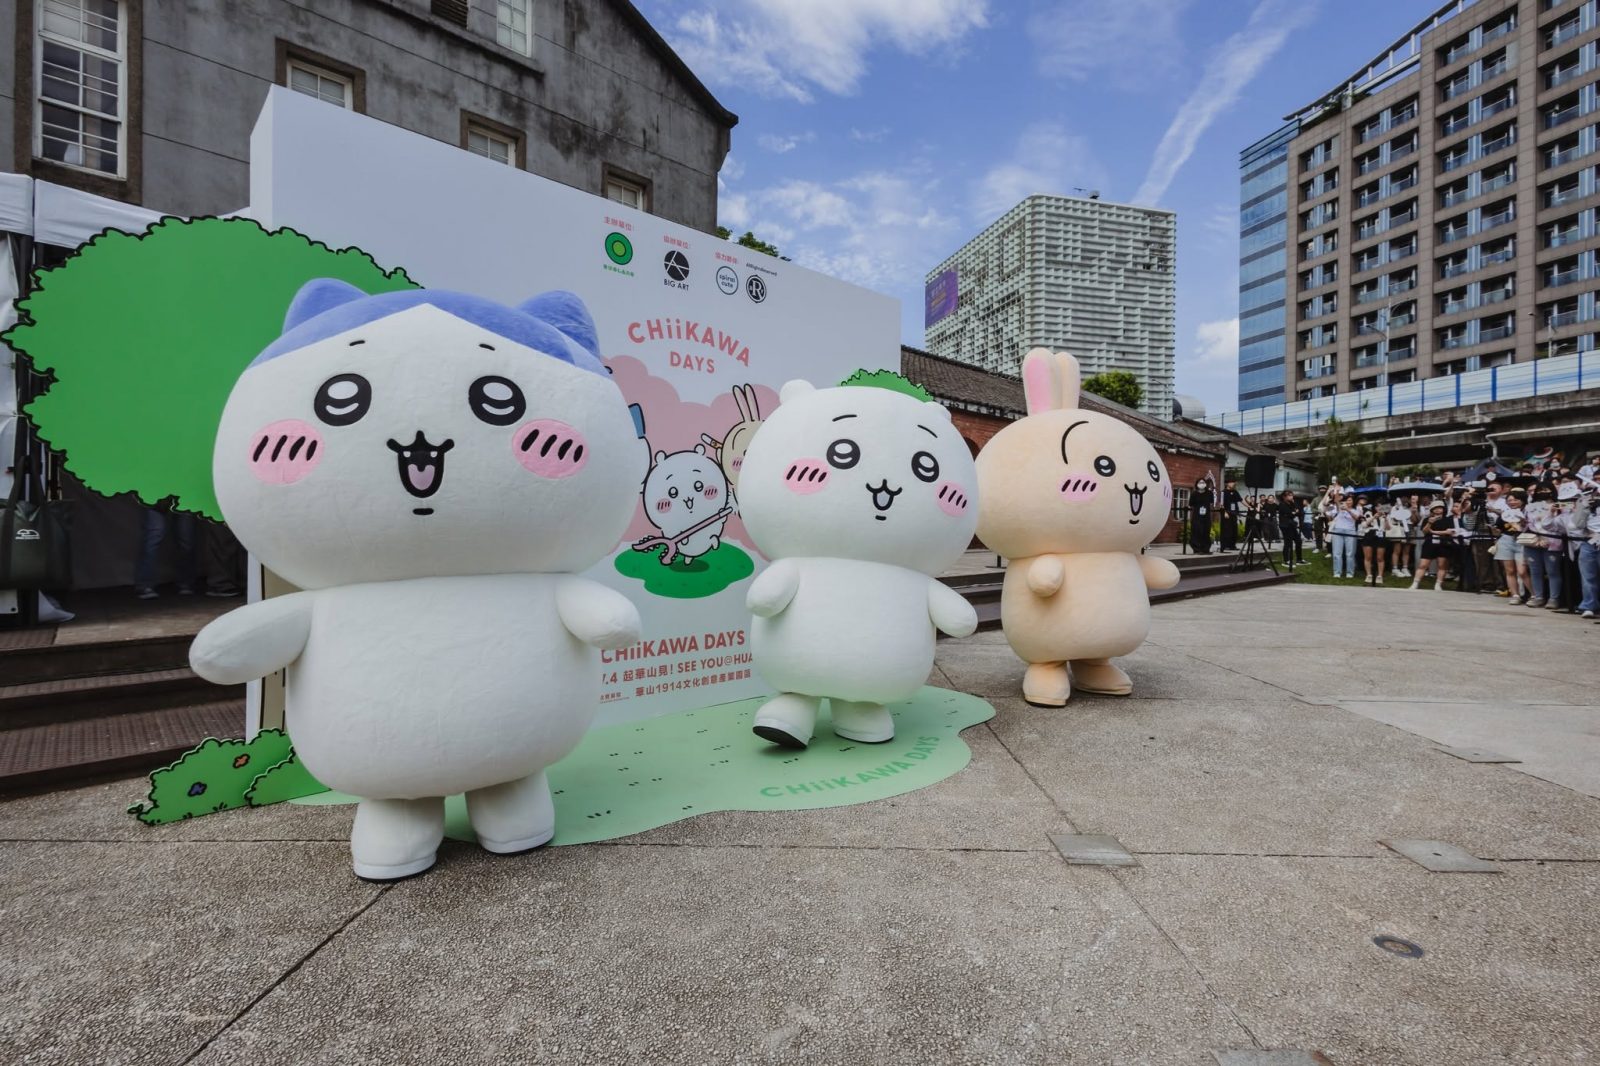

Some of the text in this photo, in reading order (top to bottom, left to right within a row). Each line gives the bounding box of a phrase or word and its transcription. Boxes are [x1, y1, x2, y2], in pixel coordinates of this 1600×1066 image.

[663, 278, 689, 291] BIG ART
[628, 317, 750, 367] CHiiKAWA
[670, 351, 715, 374] DAYS
[704, 629, 745, 650] DAYS
[678, 660, 697, 673] SEE
[904, 736, 941, 761] DAYS
